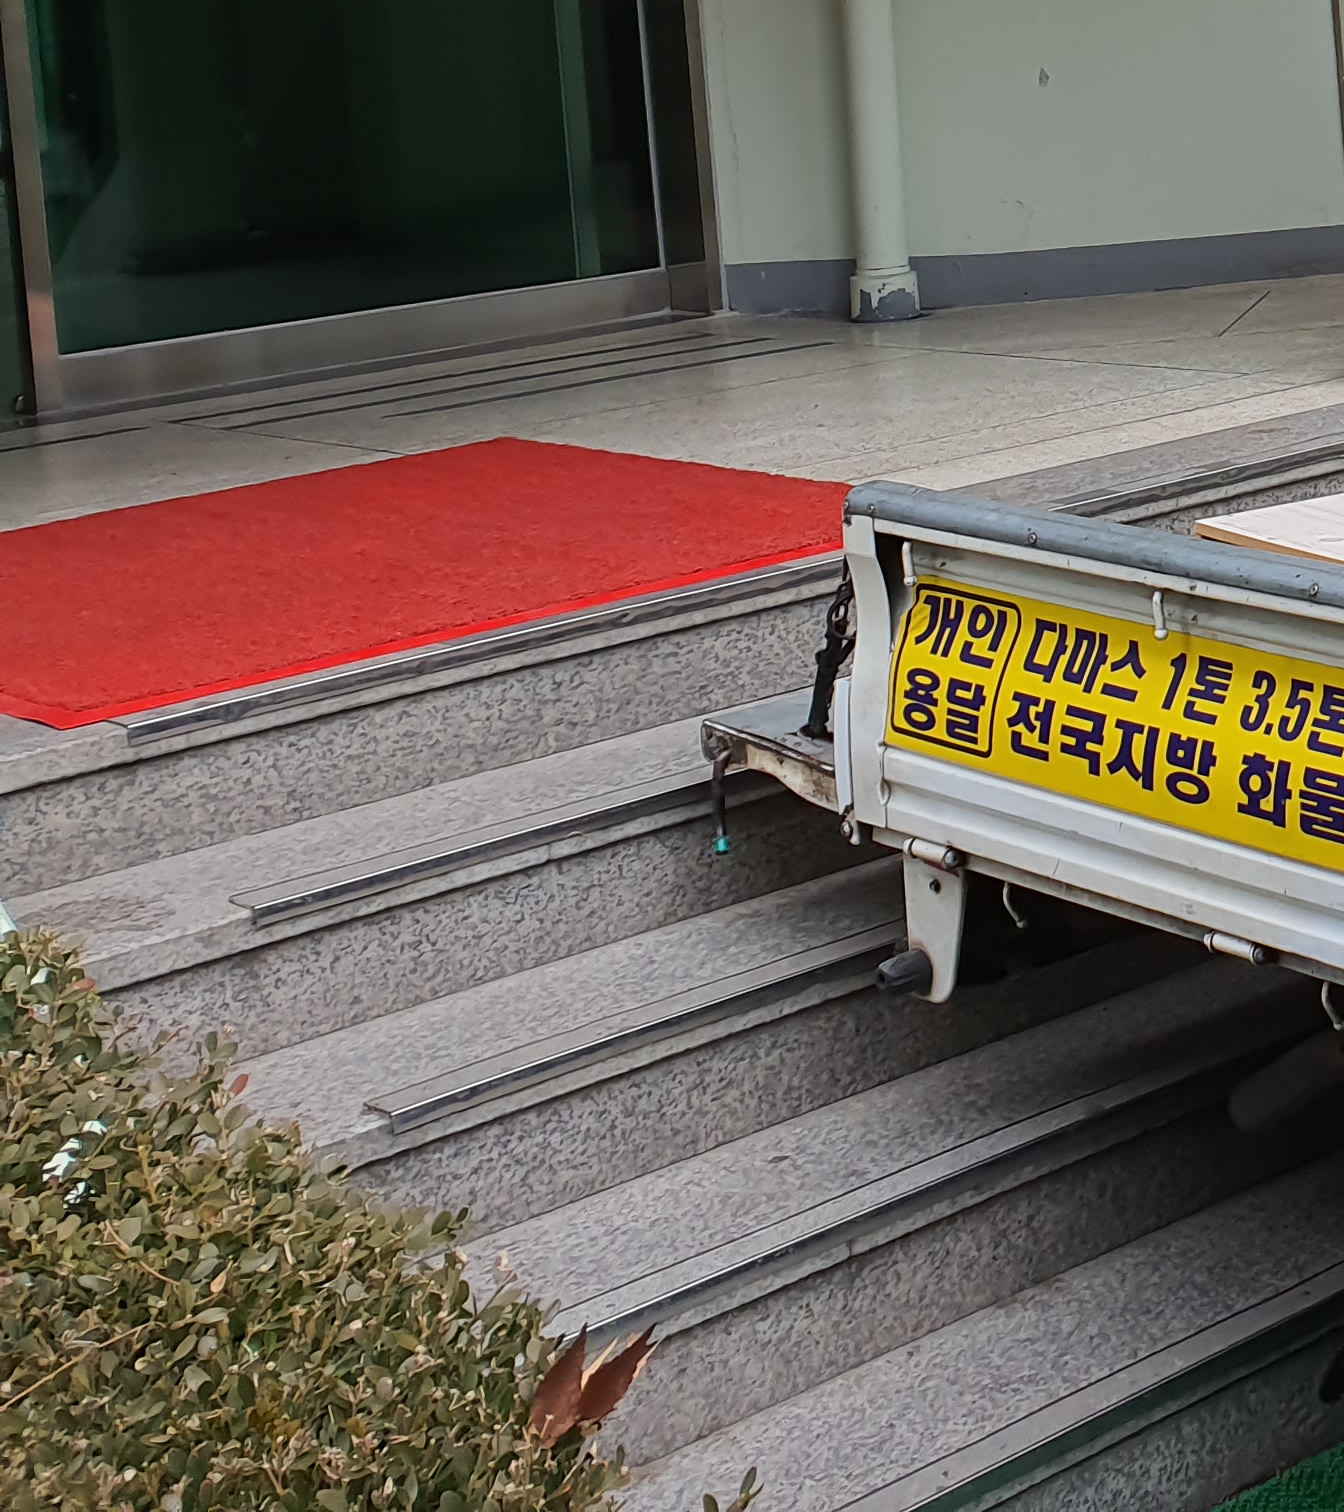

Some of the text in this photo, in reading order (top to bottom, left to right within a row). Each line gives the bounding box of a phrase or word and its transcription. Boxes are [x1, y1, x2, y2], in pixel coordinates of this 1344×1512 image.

[914, 594, 1008, 668] 개인
[1023, 618, 1147, 702] 다마스
[1161, 653, 1234, 725] 1톤
[902, 667, 987, 746] 용달
[1006, 690, 1218, 805] 전국지방
